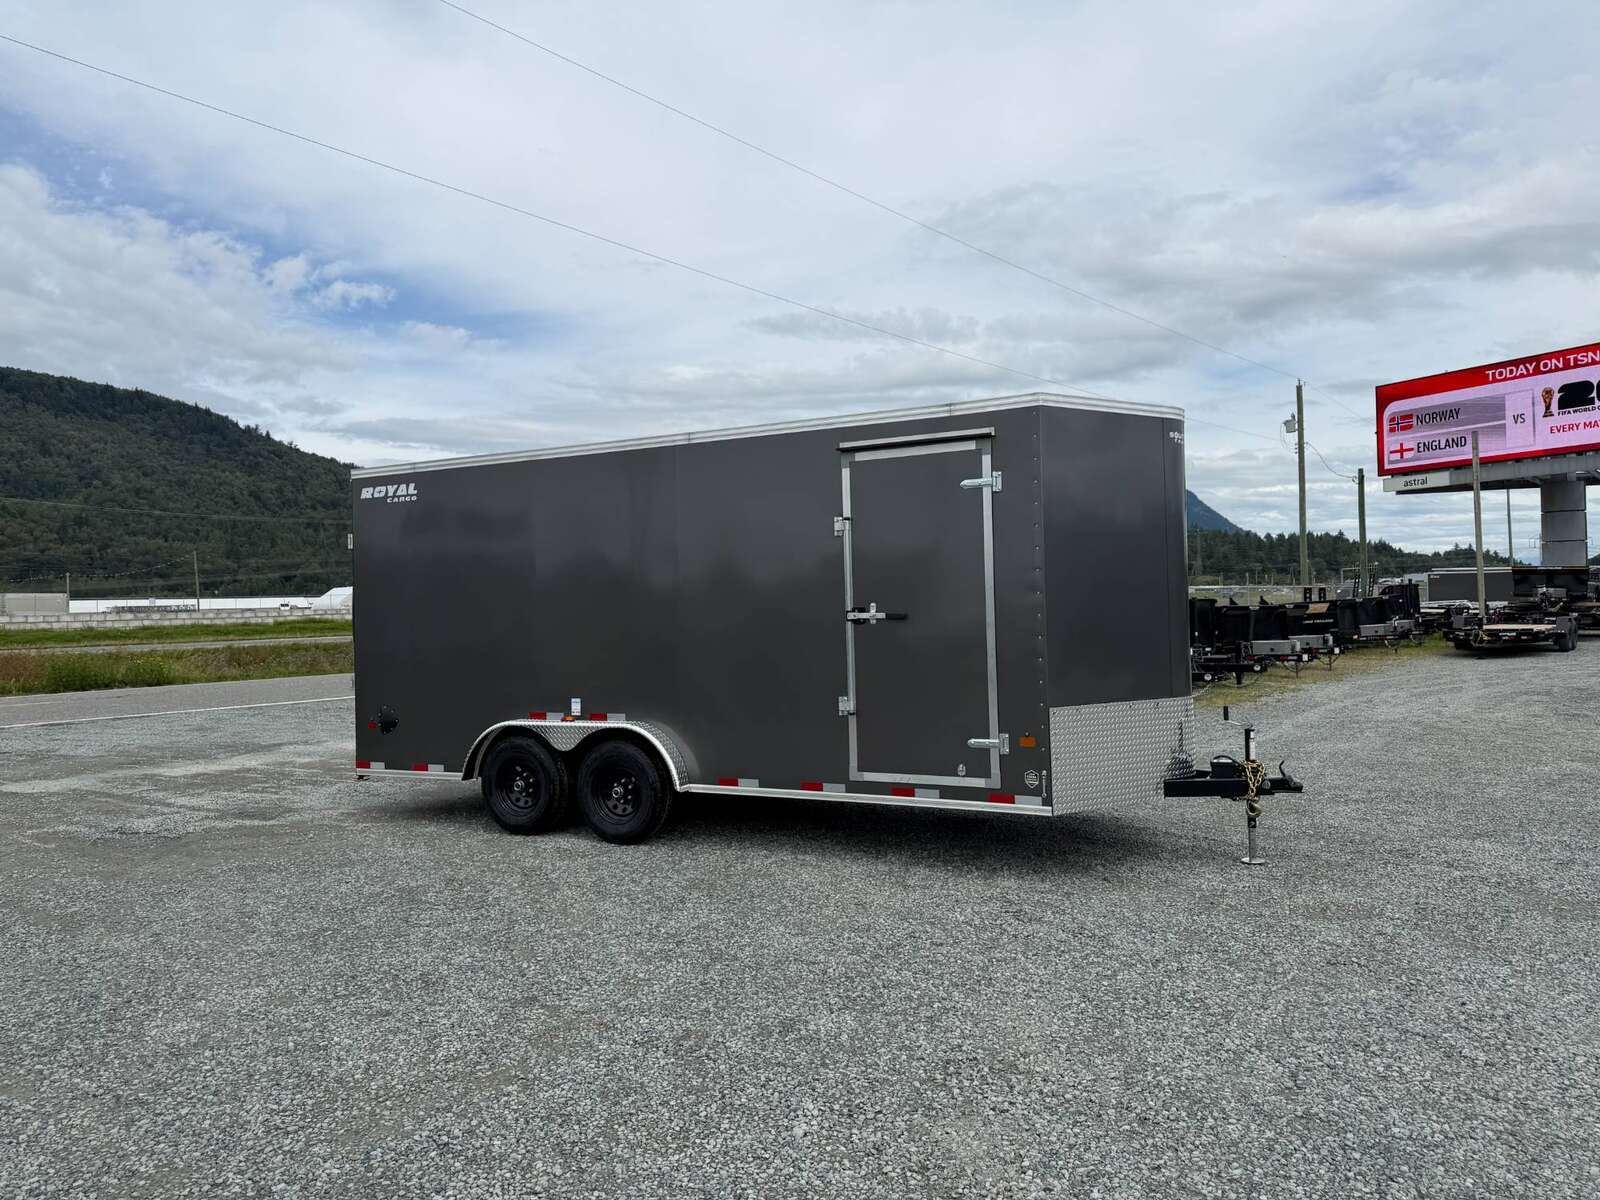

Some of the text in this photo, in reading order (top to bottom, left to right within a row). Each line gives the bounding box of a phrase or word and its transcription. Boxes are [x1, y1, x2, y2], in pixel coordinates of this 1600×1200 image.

[1486, 350, 1600, 381] TODAY ON TSN
[1416, 408, 1461, 426] NORWAY
[1572, 405, 1597, 415] WORLD
[1512, 413, 1526, 424] VS
[1550, 419, 1600, 434] EVERY MA
[1416, 436, 1467, 454] ENGLAND
[1403, 476, 1428, 488] astral
[360, 483, 418, 499] ROYAL
